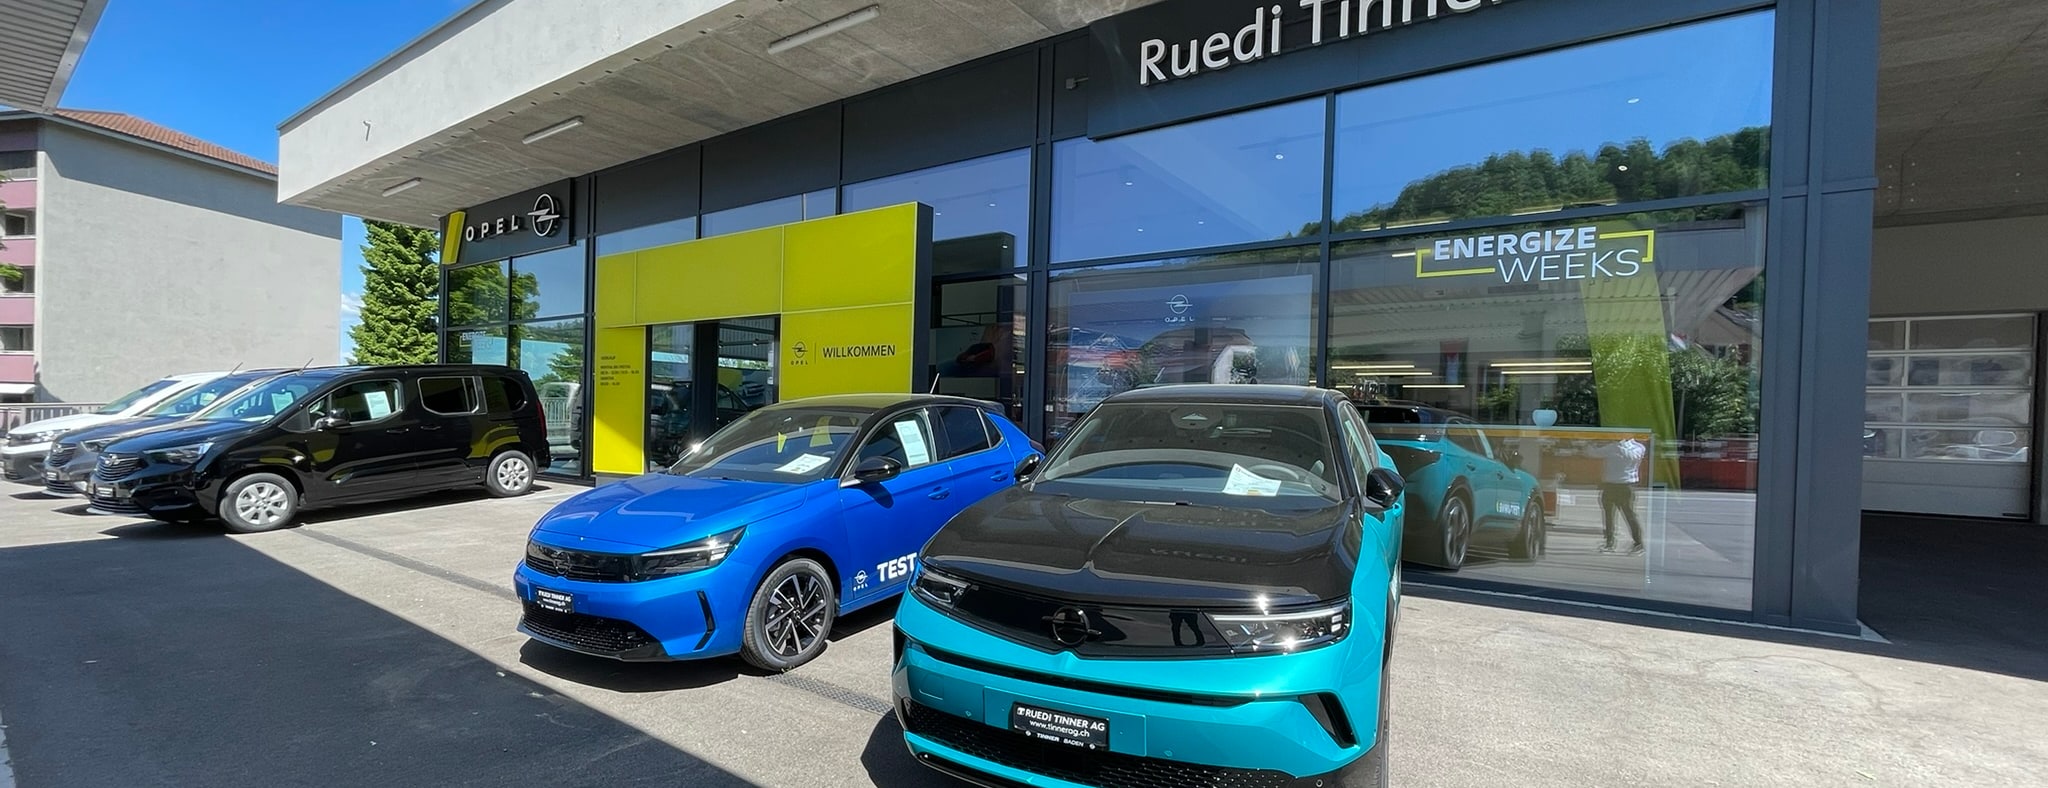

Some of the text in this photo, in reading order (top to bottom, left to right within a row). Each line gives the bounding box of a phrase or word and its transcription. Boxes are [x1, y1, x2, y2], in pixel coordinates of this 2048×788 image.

[1139, 4, 1281, 85] Ruedi
[465, 214, 518, 242] OPEL
[1434, 226, 1597, 261] ENERGIZE
[1498, 248, 1641, 283] WEEKS
[822, 344, 896, 358] WILLKOMMEN
[876, 552, 918, 583] TEST
[1025, 707, 1052, 722] RUEDI
[1053, 713, 1089, 729] TINNER
[1089, 721, 1105, 732] AG
